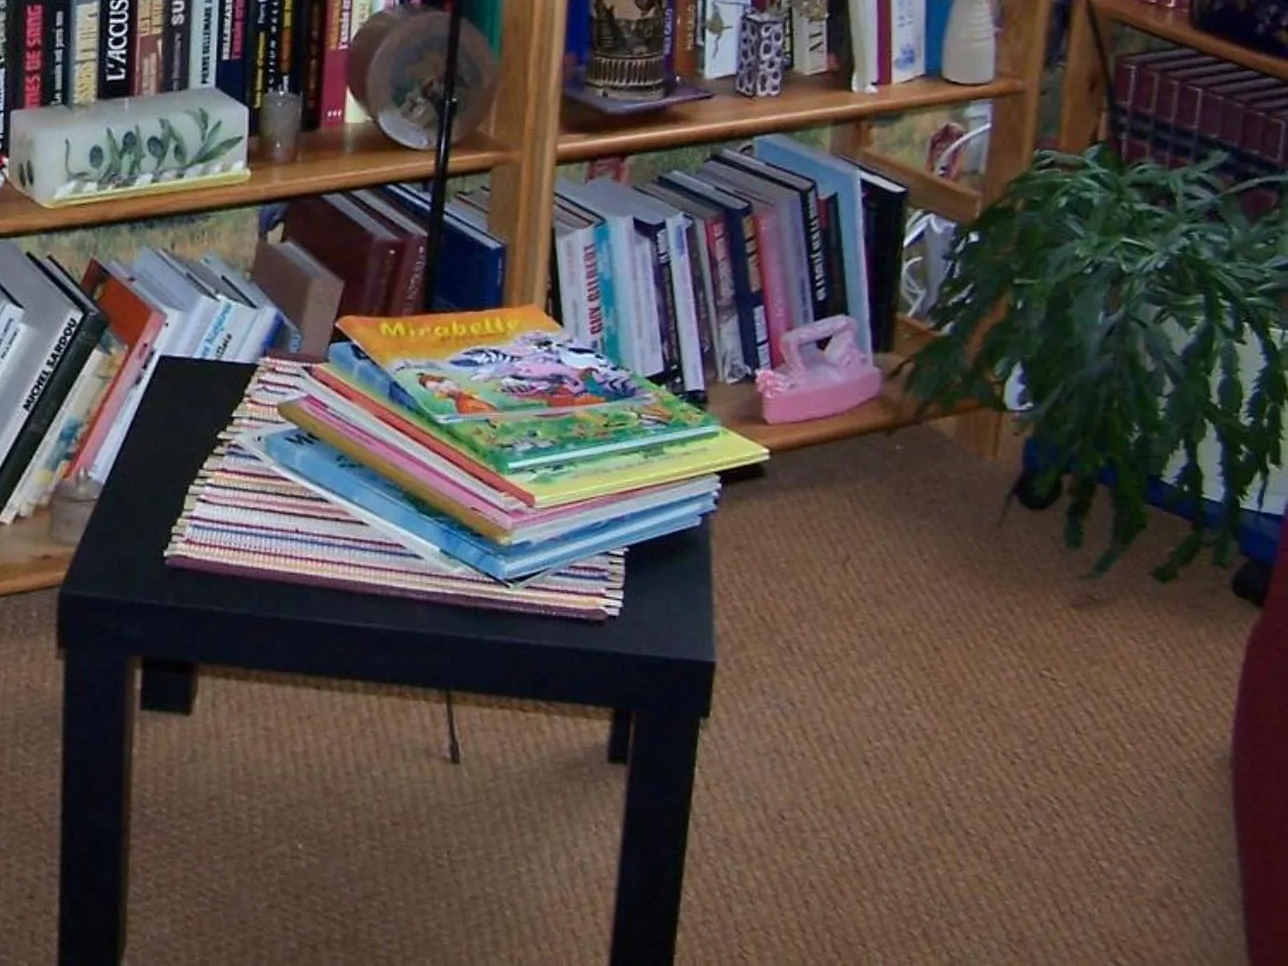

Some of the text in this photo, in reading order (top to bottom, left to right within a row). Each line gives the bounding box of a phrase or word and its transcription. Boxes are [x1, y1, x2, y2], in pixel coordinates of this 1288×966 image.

[25, 3, 43, 109] MES DE SANG
[200, 56, 211, 85] PIERRE
[201, 5, 213, 54] BELLEMARE
[583, 243, 603, 335] GUY GILBERT
[22, 317, 77, 413] MICHEL SARDOU
